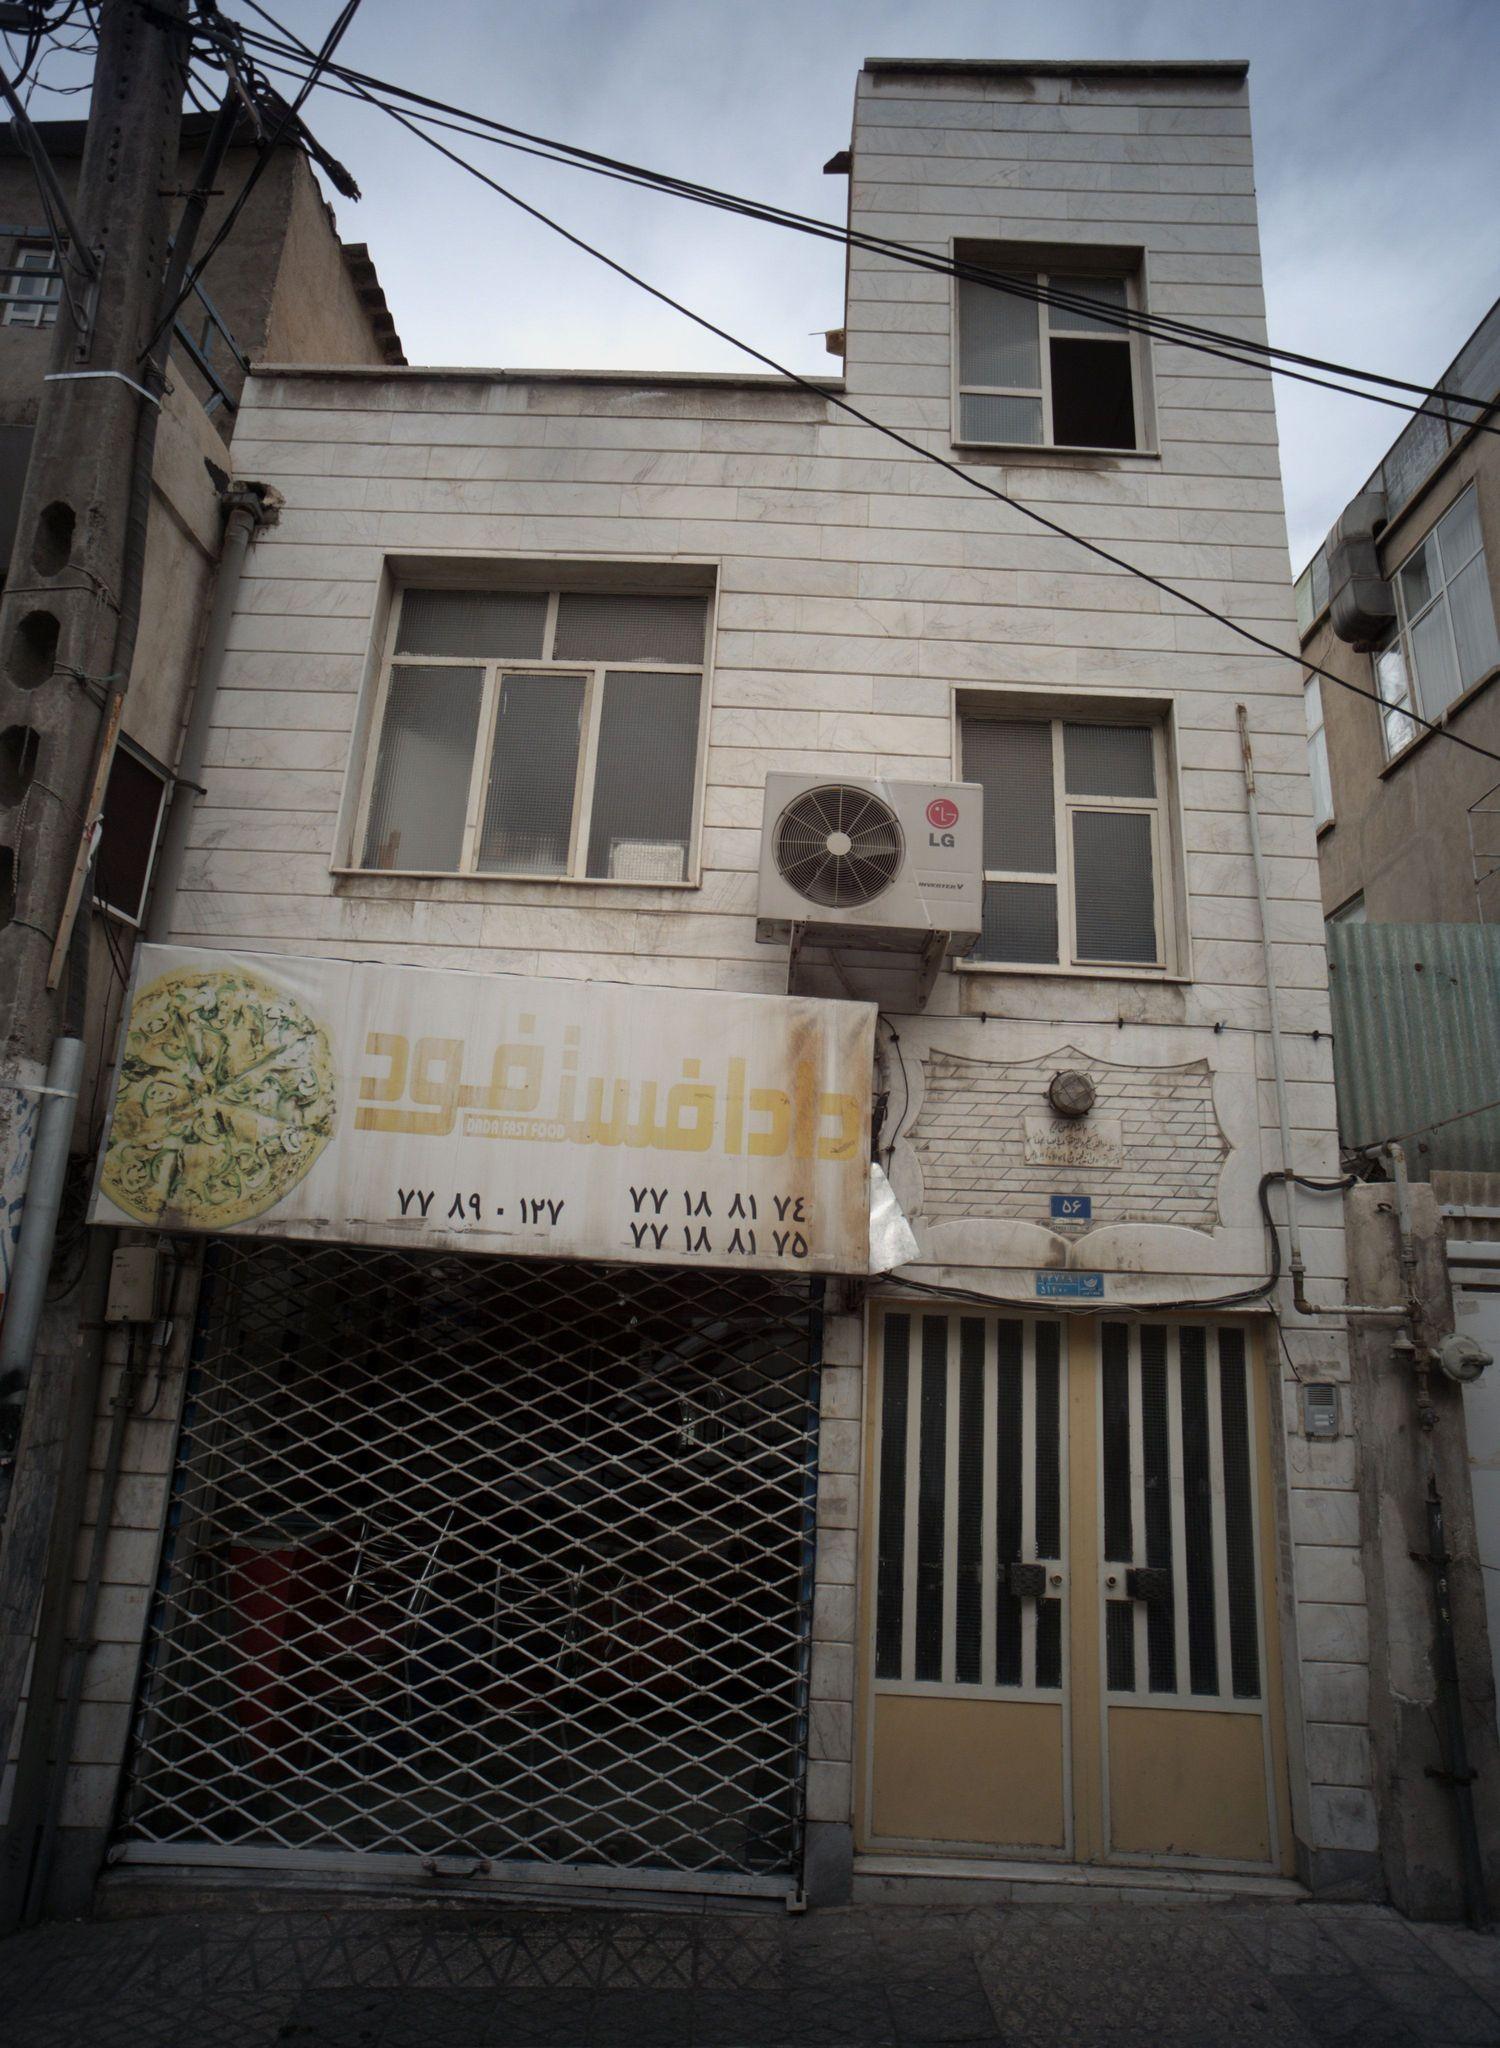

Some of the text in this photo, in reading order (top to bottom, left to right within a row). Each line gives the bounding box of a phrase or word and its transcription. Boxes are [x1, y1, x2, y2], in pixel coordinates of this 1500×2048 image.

[928, 832, 955, 848] LG
[502, 1120, 528, 1137] FAST
[531, 1122, 566, 1138] FOOD
